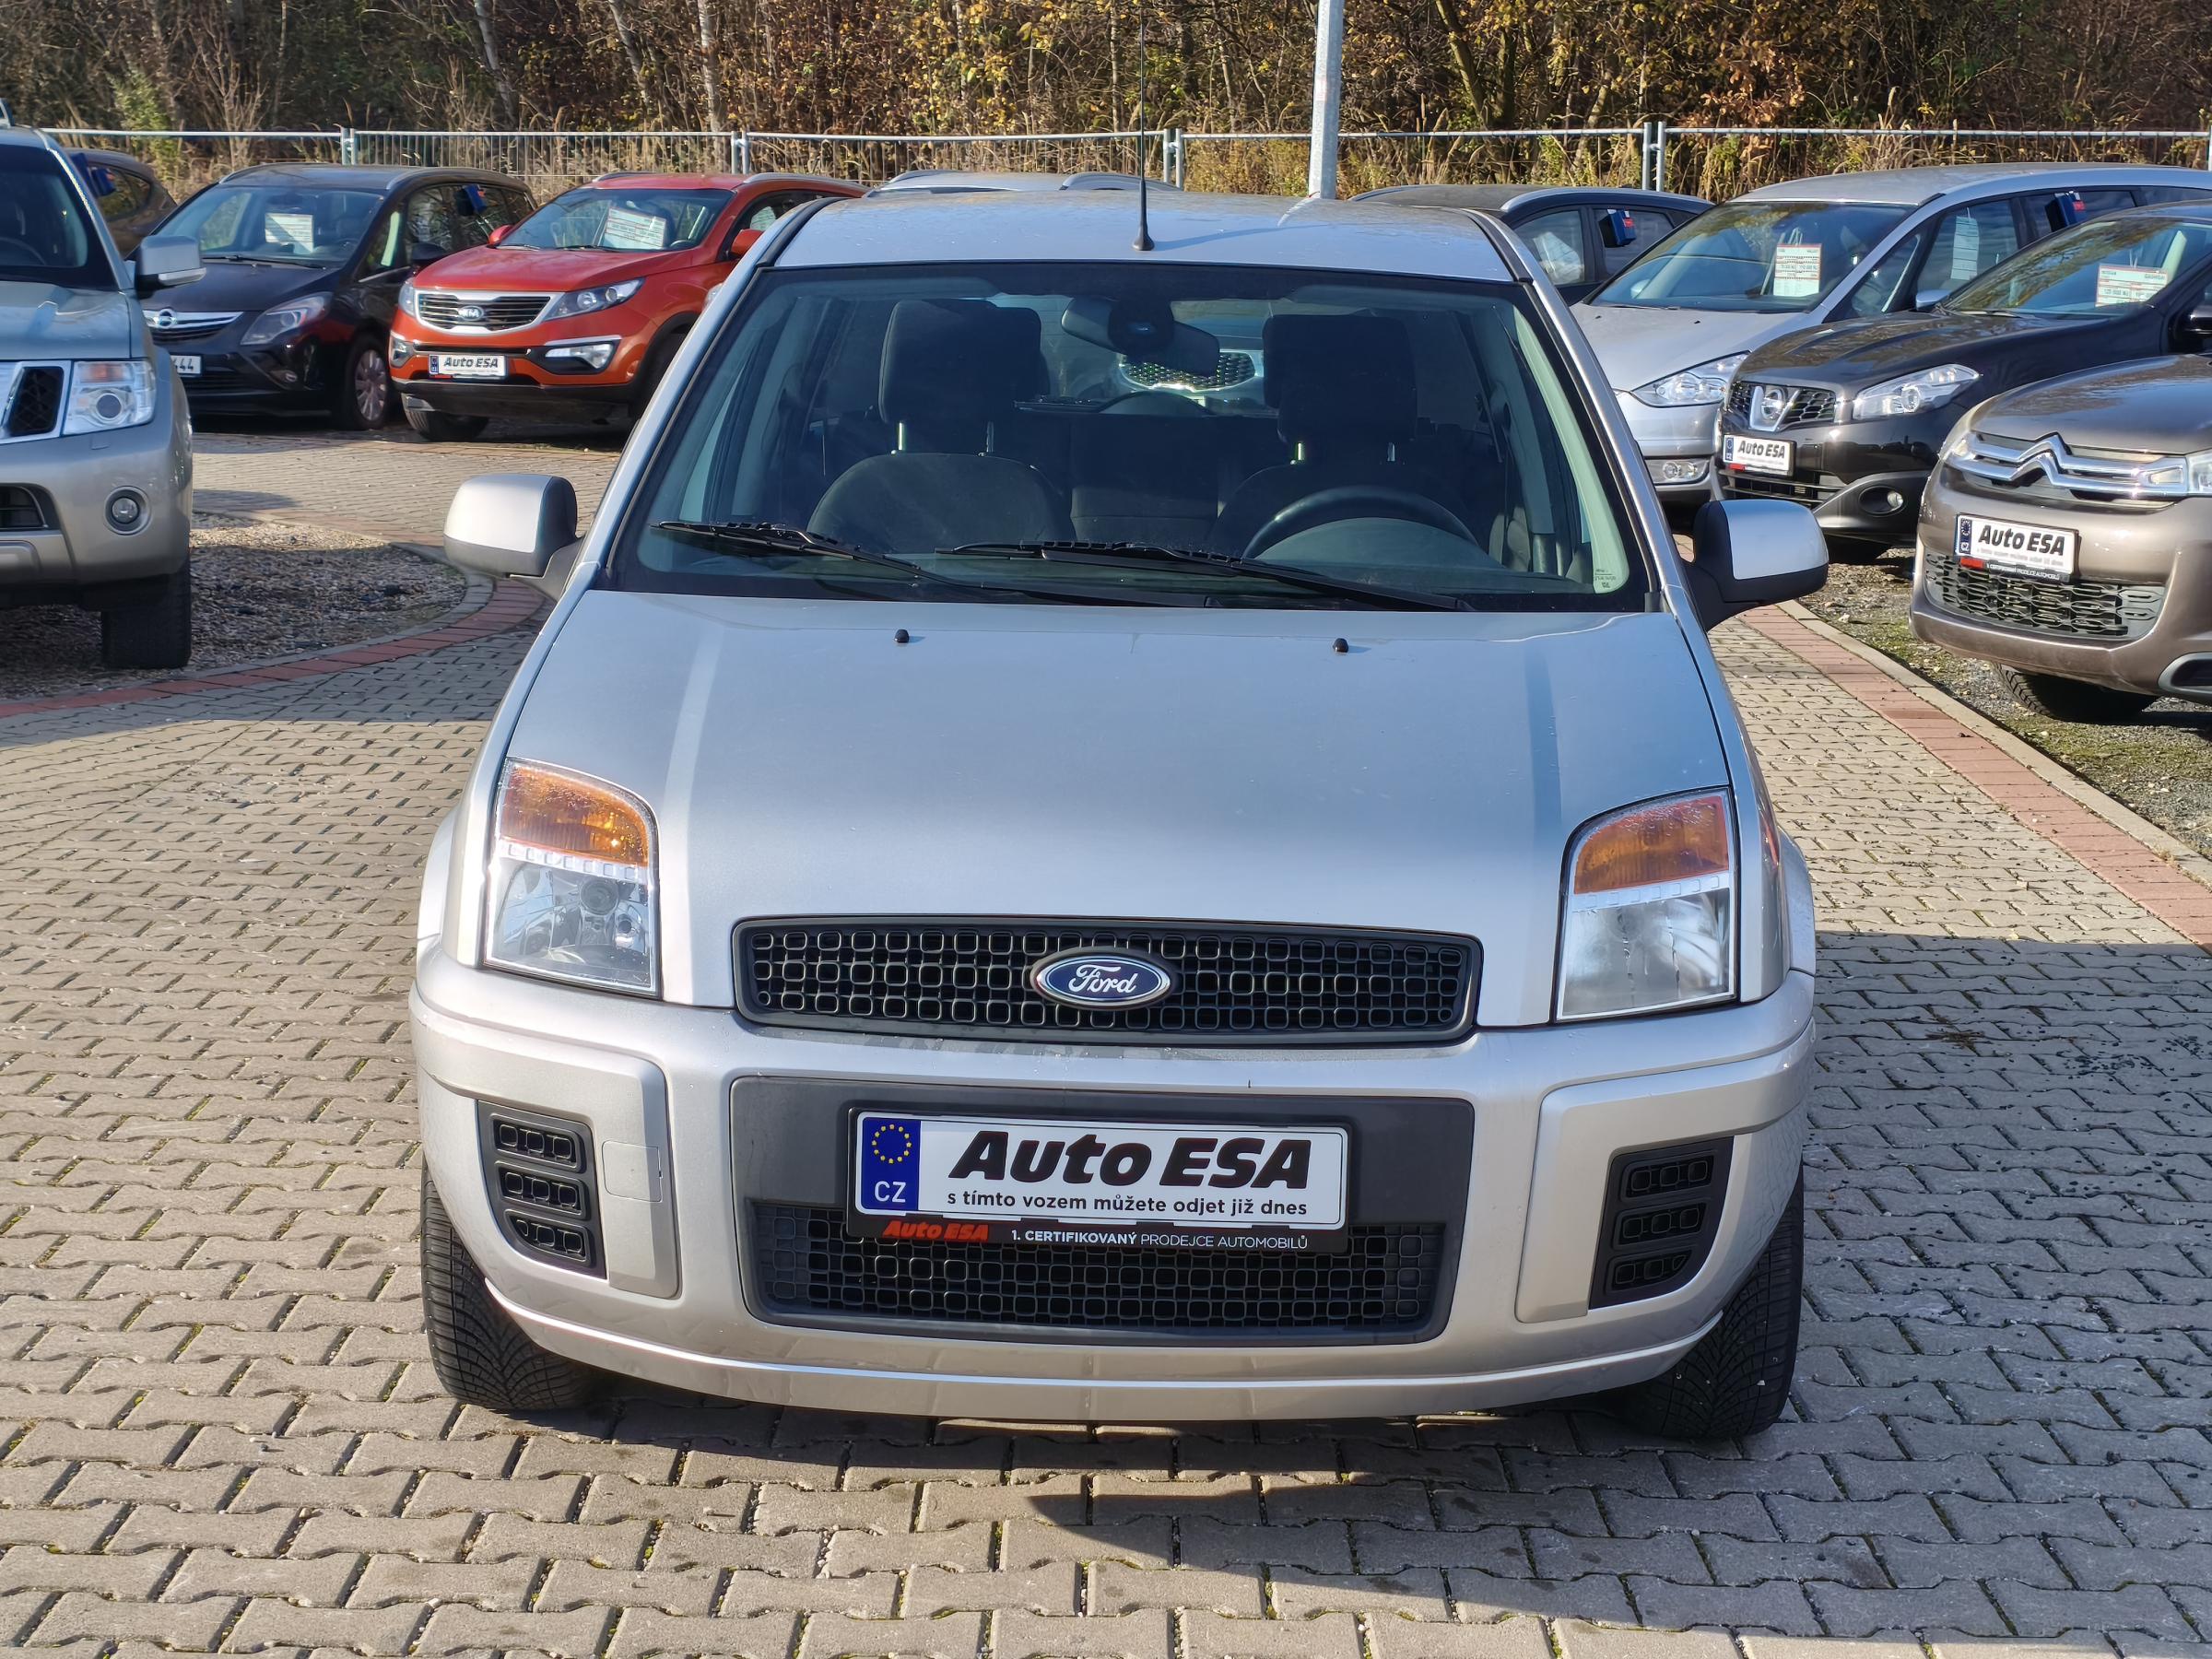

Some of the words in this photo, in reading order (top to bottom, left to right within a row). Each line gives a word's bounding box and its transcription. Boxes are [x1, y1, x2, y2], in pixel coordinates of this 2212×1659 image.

[444, 357, 474, 368] Auto
[476, 358, 499, 368] ESA
[1737, 441, 1765, 455] Auto
[1765, 443, 1785, 459] ESA
[1978, 524, 2026, 549] Auto
[2027, 532, 2065, 556] ESA
[1068, 964, 1139, 994] Ford
[948, 1130, 1152, 1187] Auto
[1159, 1136, 1312, 1189] ESA
[874, 1181, 907, 1203] CZ
[947, 1193, 957, 1205] s
[962, 1190, 1016, 1207] tímto
[1022, 1195, 1087, 1210] vozem
[1094, 1194, 1167, 1213] můžete
[1173, 1197, 1226, 1216] odjet
[1230, 1197, 1254, 1217] již
[1260, 1199, 1307, 1216] dnes
[882, 1220, 943, 1240] Auto
[944, 1222, 989, 1241] ESA
[1011, 1230, 1021, 1241] 1.
[1025, 1230, 1136, 1245] CERTIFIKOVANÝ
[1141, 1233, 1215, 1248] PRODEJCE
[1218, 1235, 1308, 1250] AUTOMOBILŮ
